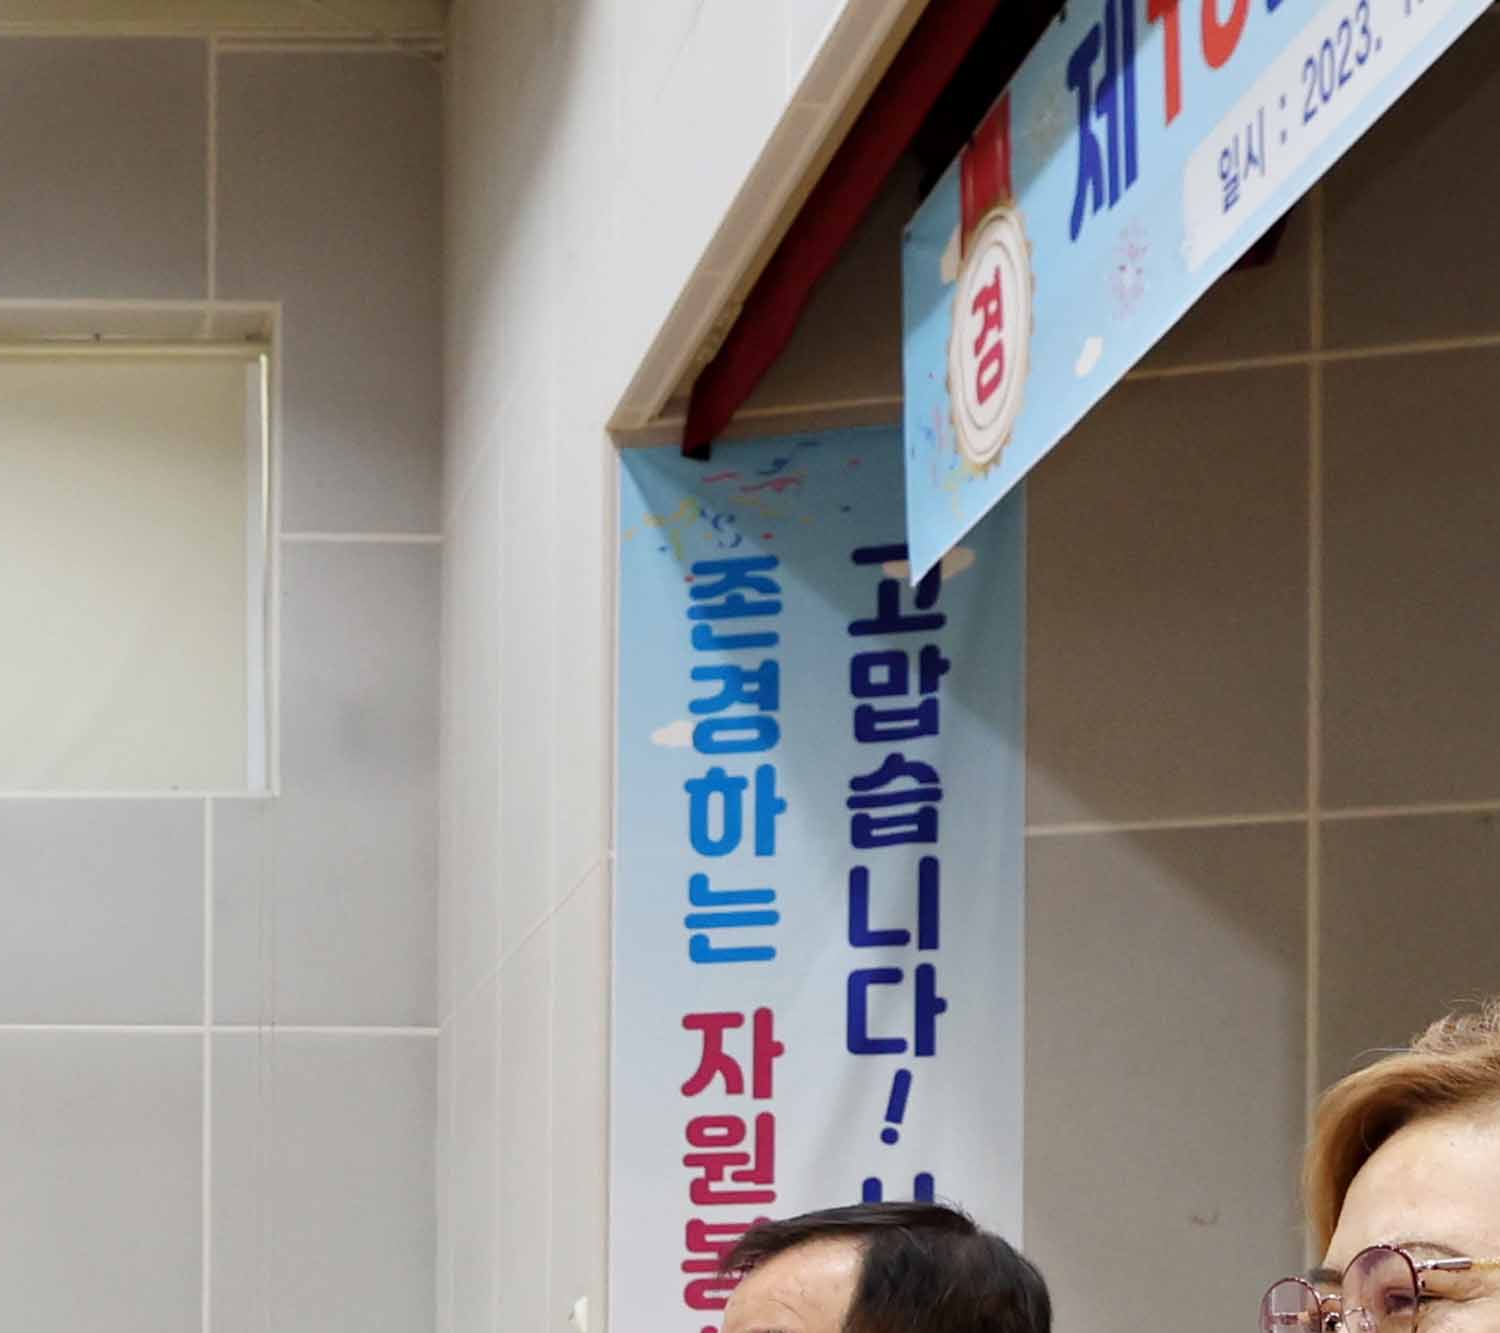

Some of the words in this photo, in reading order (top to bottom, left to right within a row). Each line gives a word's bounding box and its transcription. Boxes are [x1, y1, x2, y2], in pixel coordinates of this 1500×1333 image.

[1218, 105, 1266, 215] 일시
[1301, 0, 1383, 126] 2023.
[972, 264, 1004, 406] 경
[683, 554, 787, 964] 존경하는
[846, 543, 950, 1146] 고맙습니다!
